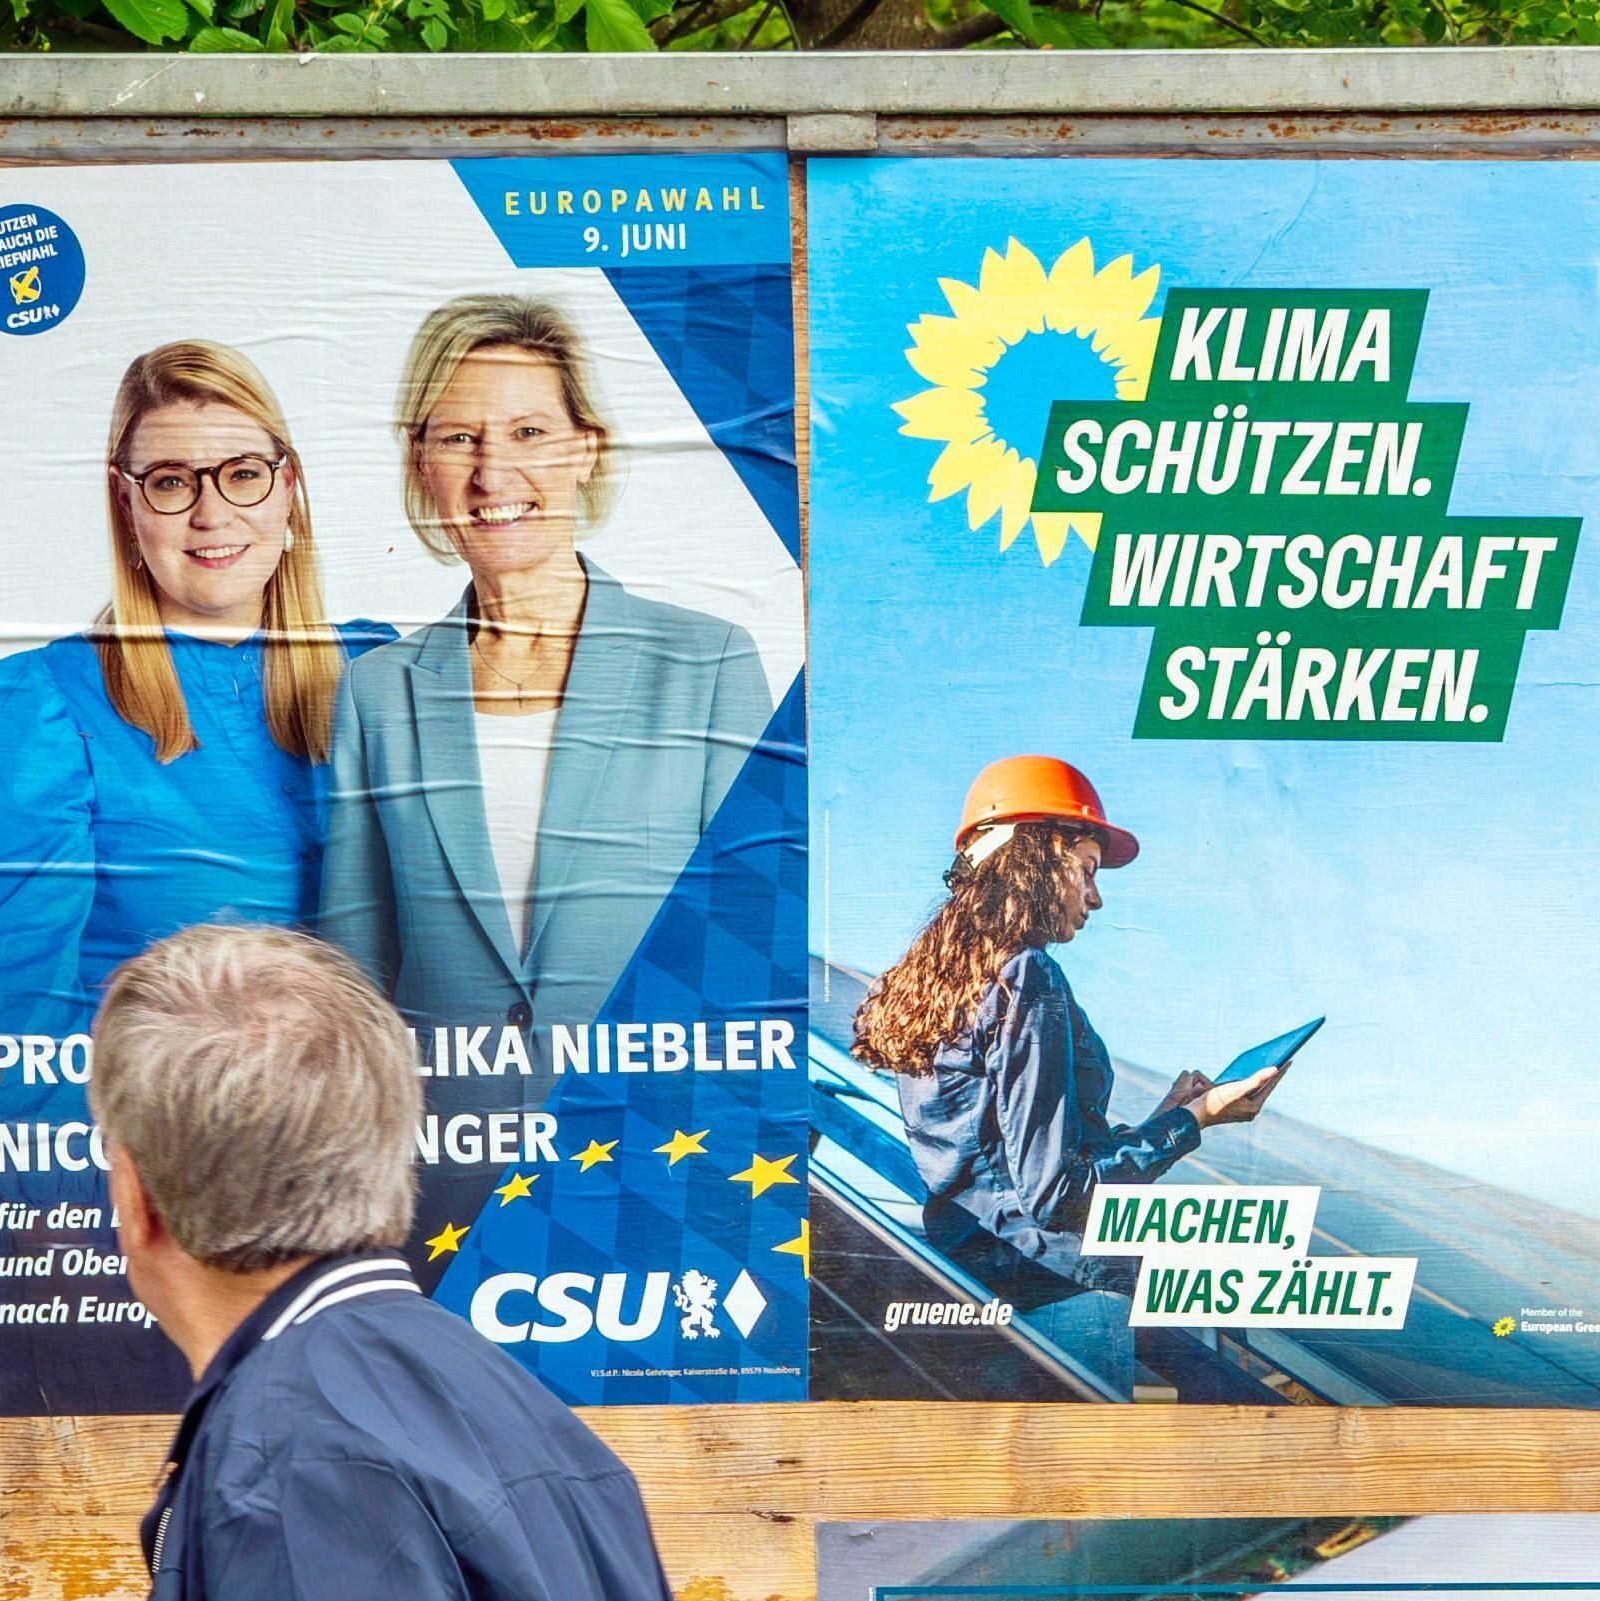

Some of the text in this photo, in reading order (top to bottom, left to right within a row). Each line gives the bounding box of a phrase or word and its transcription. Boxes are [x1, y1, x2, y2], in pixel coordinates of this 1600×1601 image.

[505, 187, 765, 216] EUROPAWAHL
[35, 226, 58, 242] DIE
[583, 223, 686, 258] 9. JUNI
[7, 307, 42, 328] CSU
[1170, 307, 1390, 382] KLIMA
[1056, 404, 1431, 496] SCHÜTZEN.
[1109, 533, 1555, 611] WIRTSCHAFT
[1159, 631, 1489, 723] STÄRKEN.
[406, 1020, 797, 1076] LIKA NIEBLER
[409, 1112, 560, 1165] NGER
[47, 1202, 101, 1229] den
[1098, 1196, 1295, 1252] MACHEN,
[63, 1249, 128, 1275] Ober
[1146, 1259, 1393, 1317] WAS ZÄHLT.
[78, 1297, 158, 1328] Europ
[470, 1272, 671, 1344] CSU
[884, 1297, 1012, 1332] gruene.de
[1521, 1308, 1583, 1317] Member of the
[1521, 1322, 1572, 1334] European
